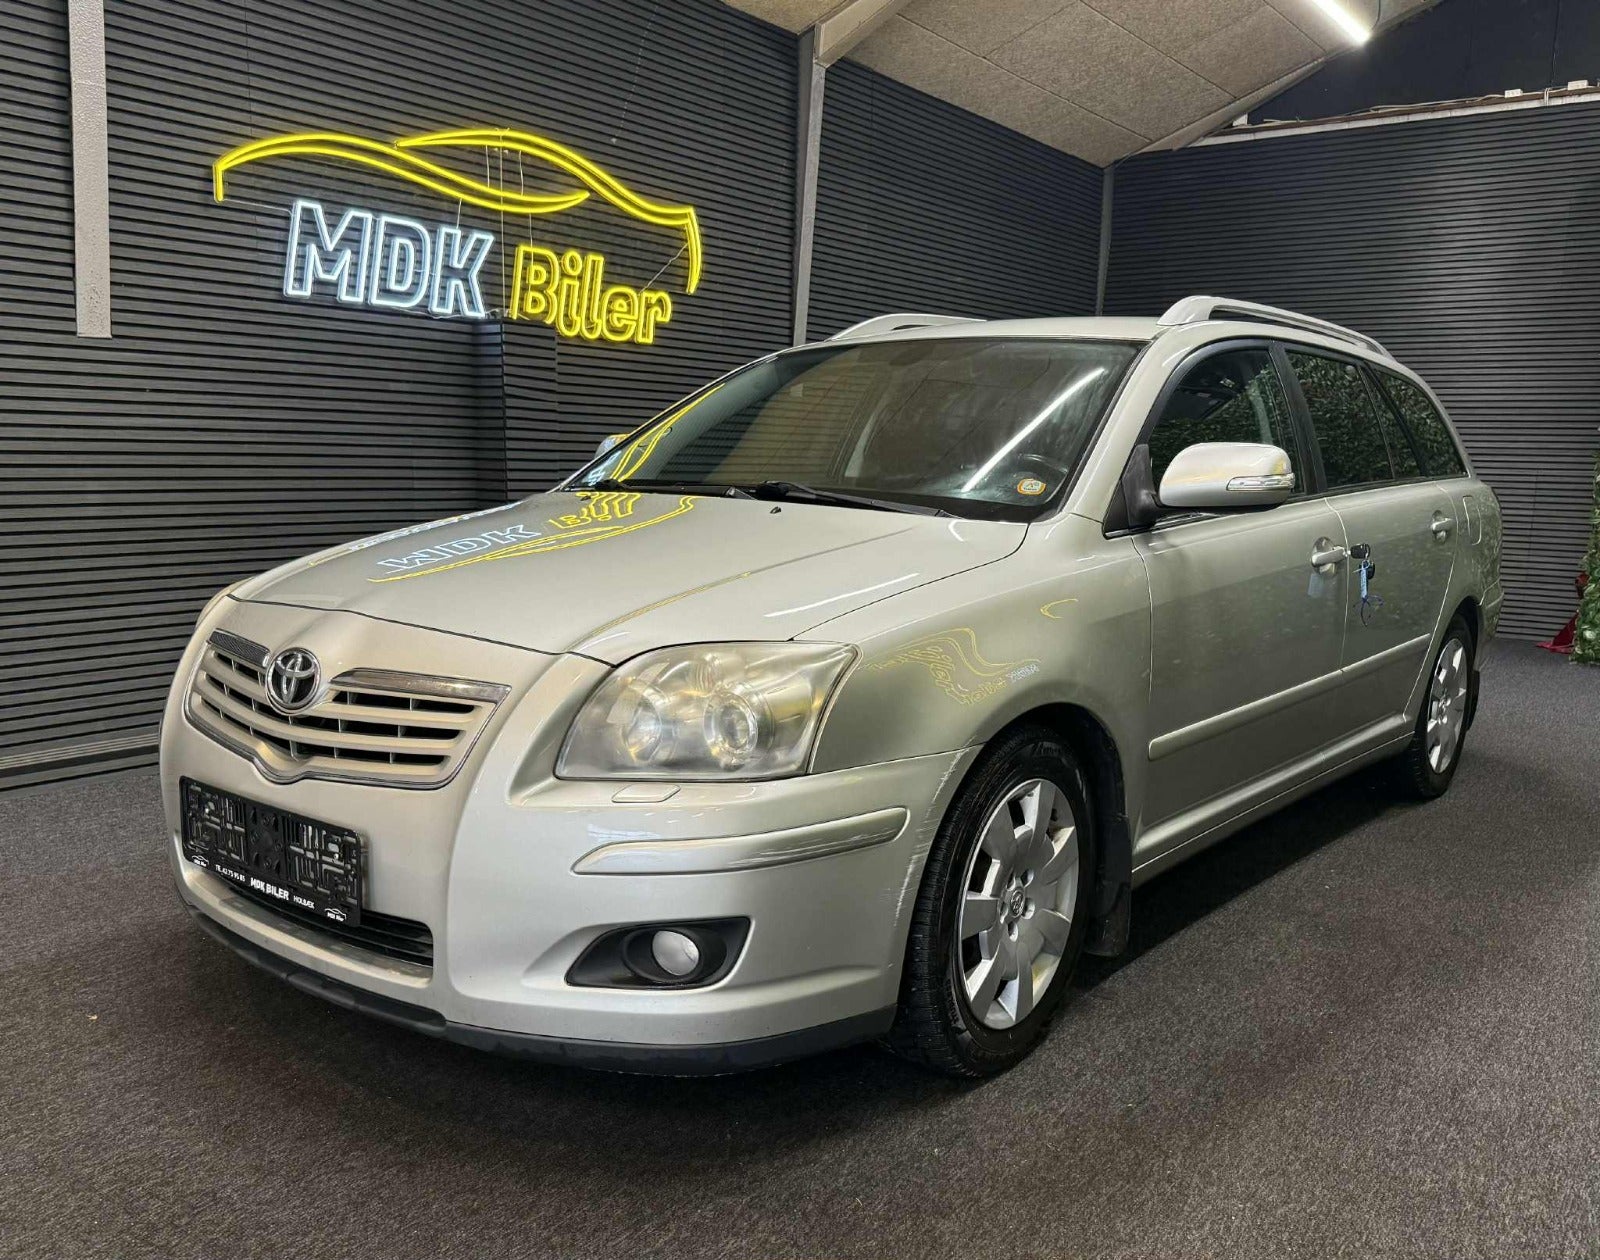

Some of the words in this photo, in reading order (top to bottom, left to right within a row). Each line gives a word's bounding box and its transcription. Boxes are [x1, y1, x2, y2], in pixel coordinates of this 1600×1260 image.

[283, 200, 495, 319] MDK
[508, 244, 673, 344] Biler
[250, 877, 266, 893] MDK
[266, 883, 289, 901] BILER
